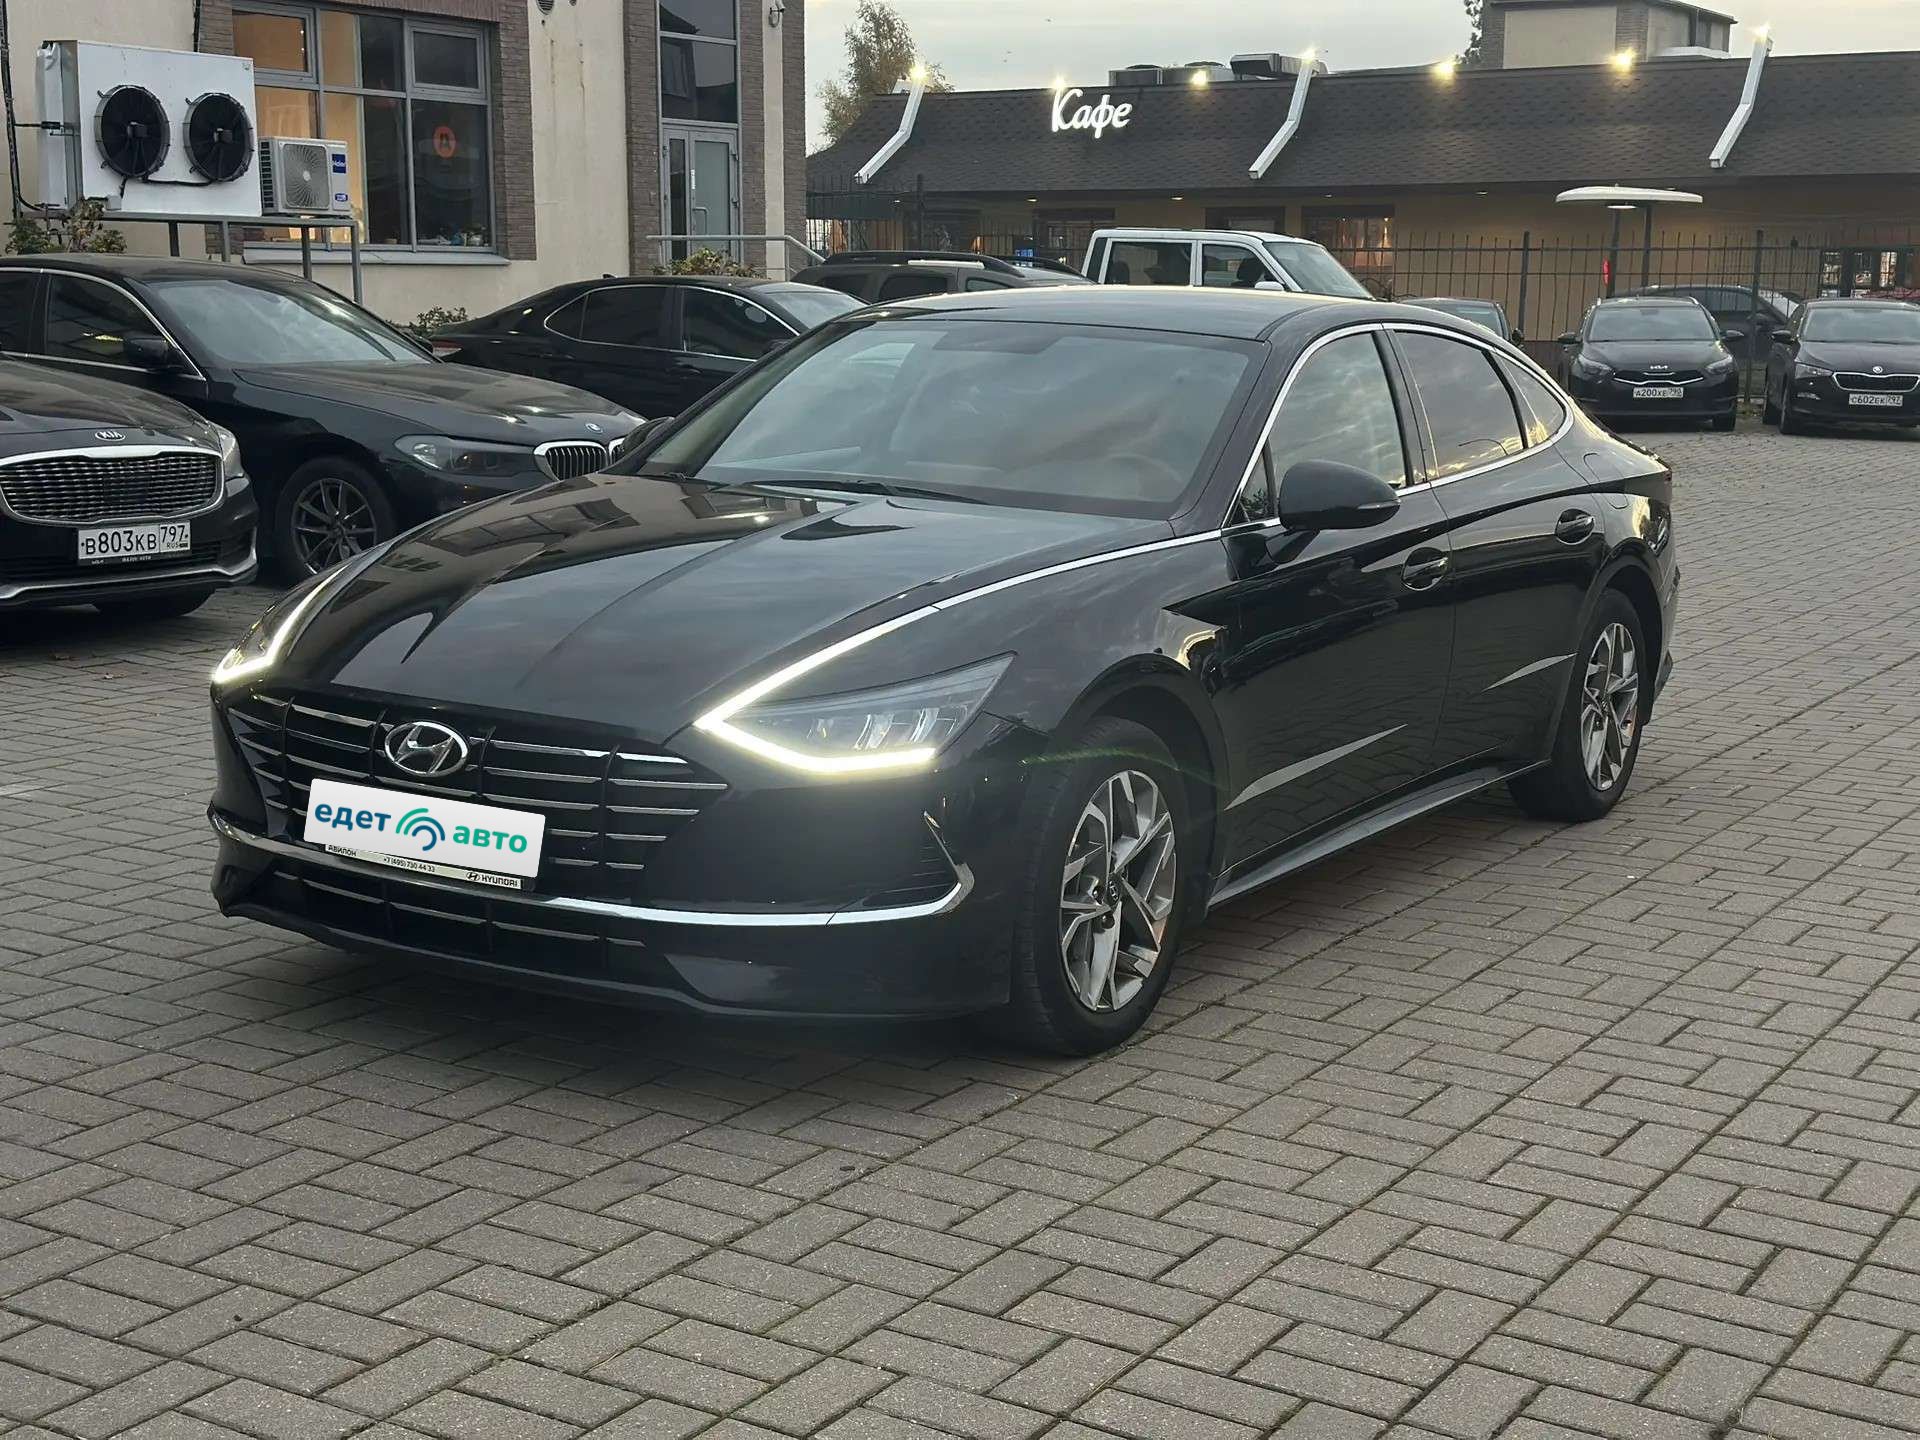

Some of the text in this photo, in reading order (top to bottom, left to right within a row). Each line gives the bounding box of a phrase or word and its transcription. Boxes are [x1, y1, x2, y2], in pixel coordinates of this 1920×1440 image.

[1052, 87, 1132, 138] Кафе
[161, 525, 185, 543] 797
[482, 874, 518, 888] HYUNDAI
